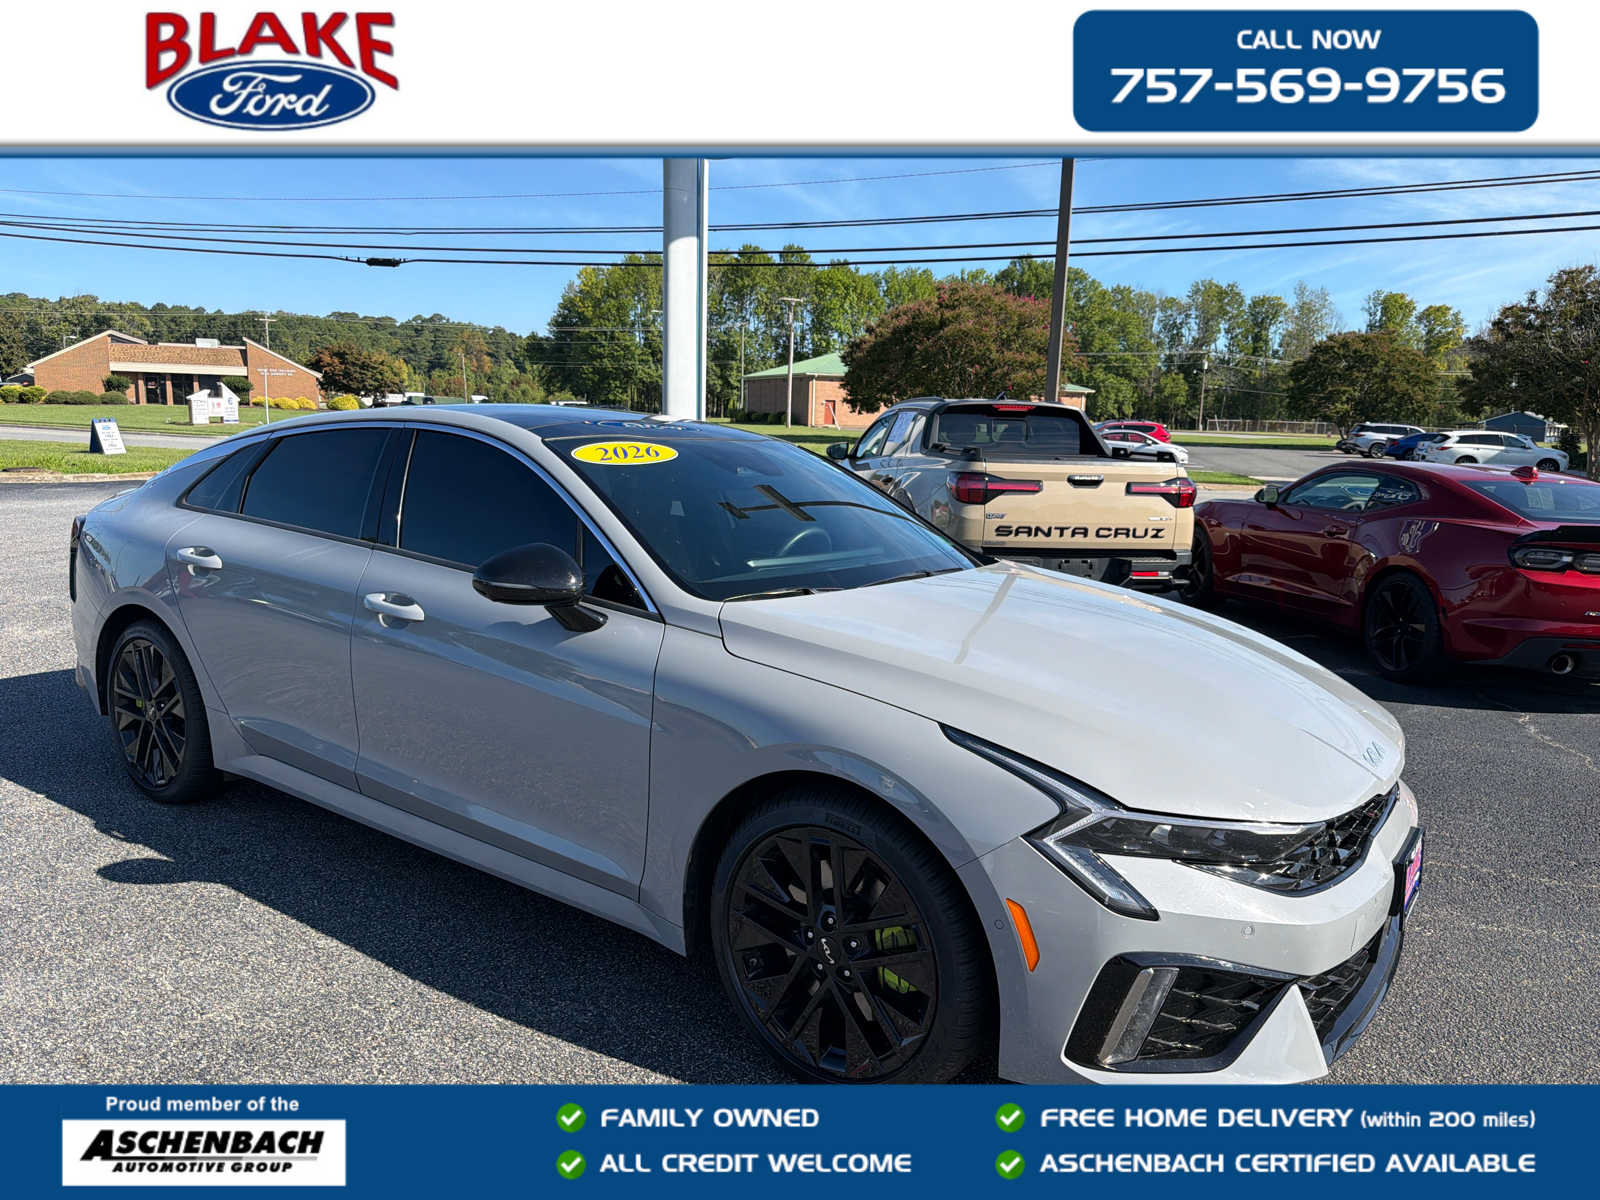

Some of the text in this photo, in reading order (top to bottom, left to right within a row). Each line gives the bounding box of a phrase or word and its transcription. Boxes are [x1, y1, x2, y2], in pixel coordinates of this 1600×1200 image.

[595, 445, 660, 461] 2026
[994, 525, 1166, 540] SANTA CRUZ
